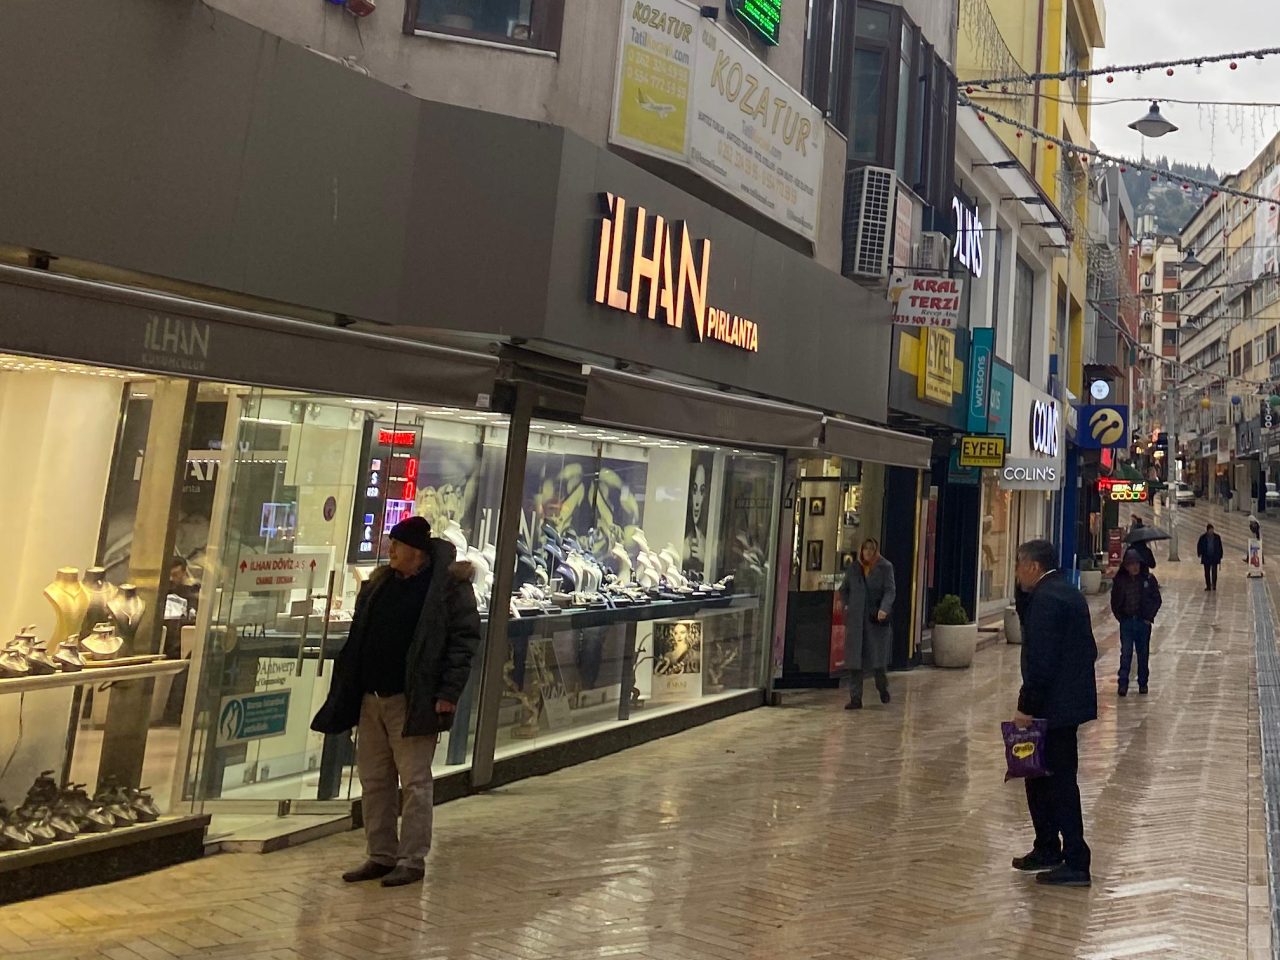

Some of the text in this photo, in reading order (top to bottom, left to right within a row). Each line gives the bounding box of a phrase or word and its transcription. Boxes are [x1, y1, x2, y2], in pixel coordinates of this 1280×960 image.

[595, 192, 711, 343] İLHAN
[913, 279, 959, 293] KRAL
[909, 295, 958, 311] TERZİ
[144, 313, 210, 359] İLHAN
[706, 306, 758, 353] PIRLANTA
[974, 355, 986, 408] watsons
[963, 441, 1001, 457] EYFEL
[1033, 400, 1058, 457] COLIN'S
[1003, 467, 1056, 481] COLIN'S
